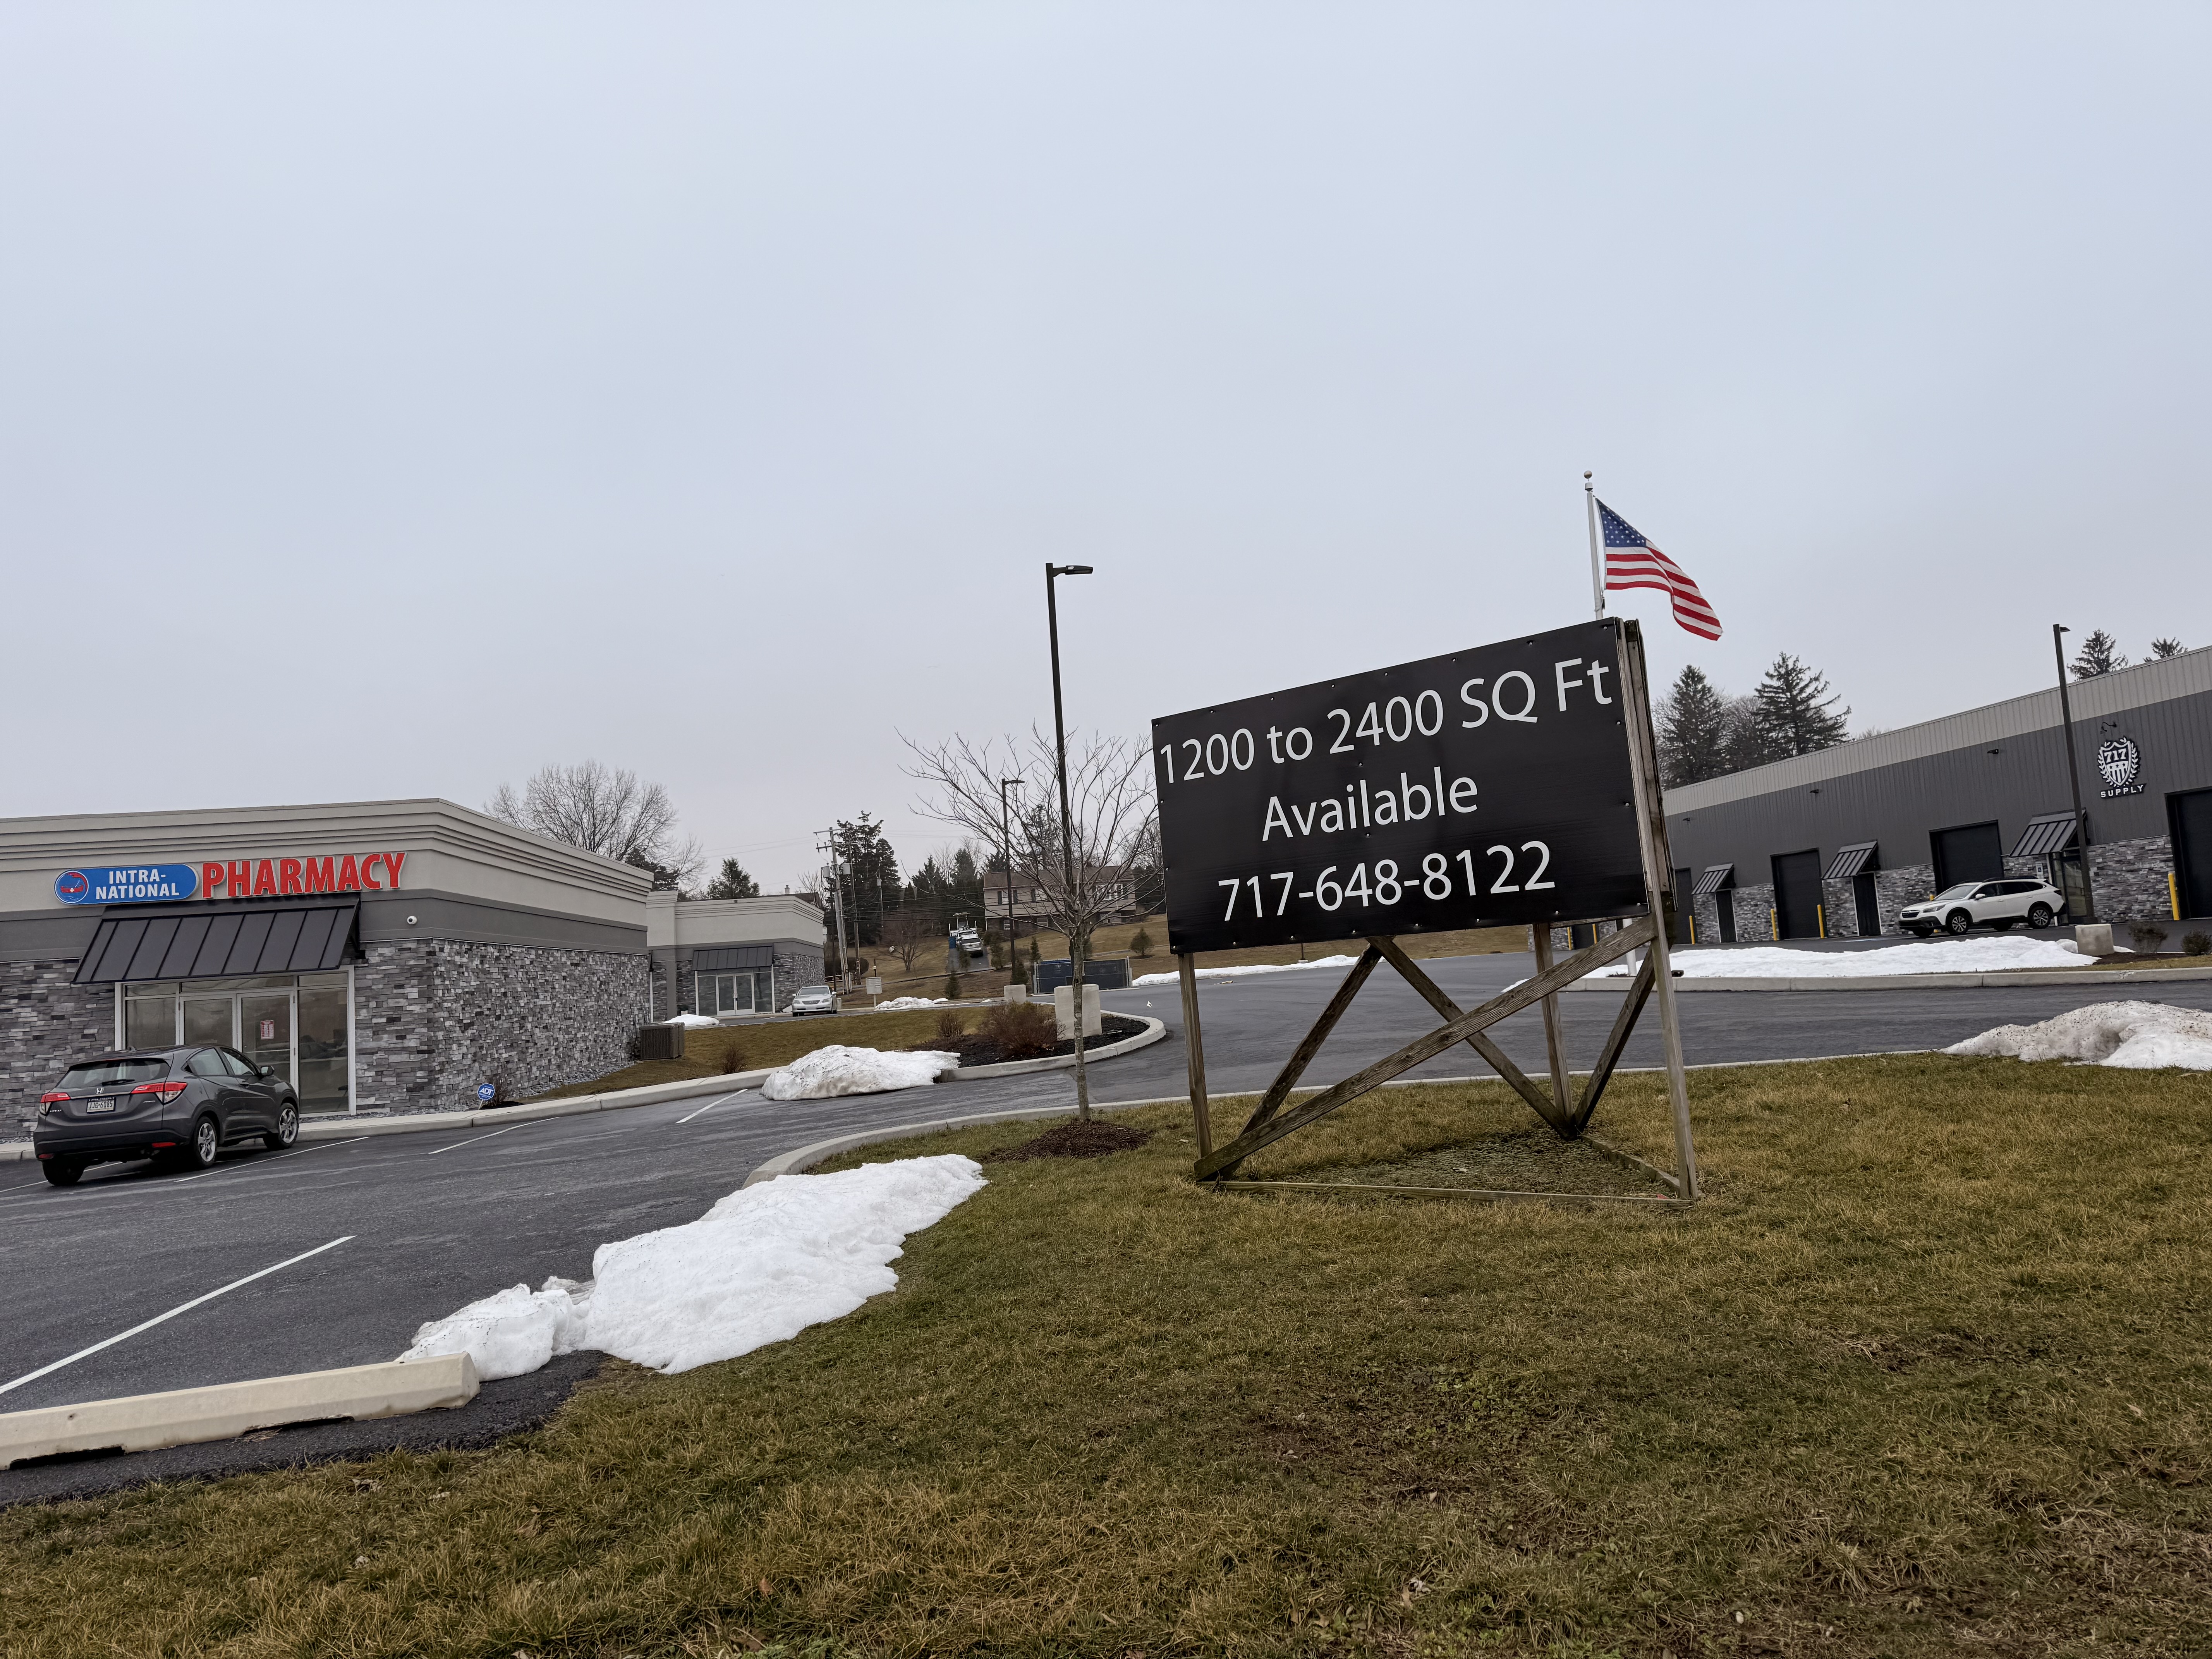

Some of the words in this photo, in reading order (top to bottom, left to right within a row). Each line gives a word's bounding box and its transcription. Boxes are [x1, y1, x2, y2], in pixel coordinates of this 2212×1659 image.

[1160, 728, 1254, 784] 1200
[1266, 725, 1313, 764] to
[1327, 690, 1443, 754] 2400
[1460, 670, 1538, 728] SQ
[1555, 658, 1612, 712] Ft
[2104, 748, 2126, 763] 717
[2100, 785, 2143, 798] SUPPLY
[1262, 766, 1478, 841] Available
[109, 869, 166, 884] INTRA-
[203, 853, 405, 898] PHARMACY
[1218, 841, 1555, 921] 717-648-8122
[96, 883, 180, 900] NATIONAL
[479, 1087, 494, 1096] ADT
